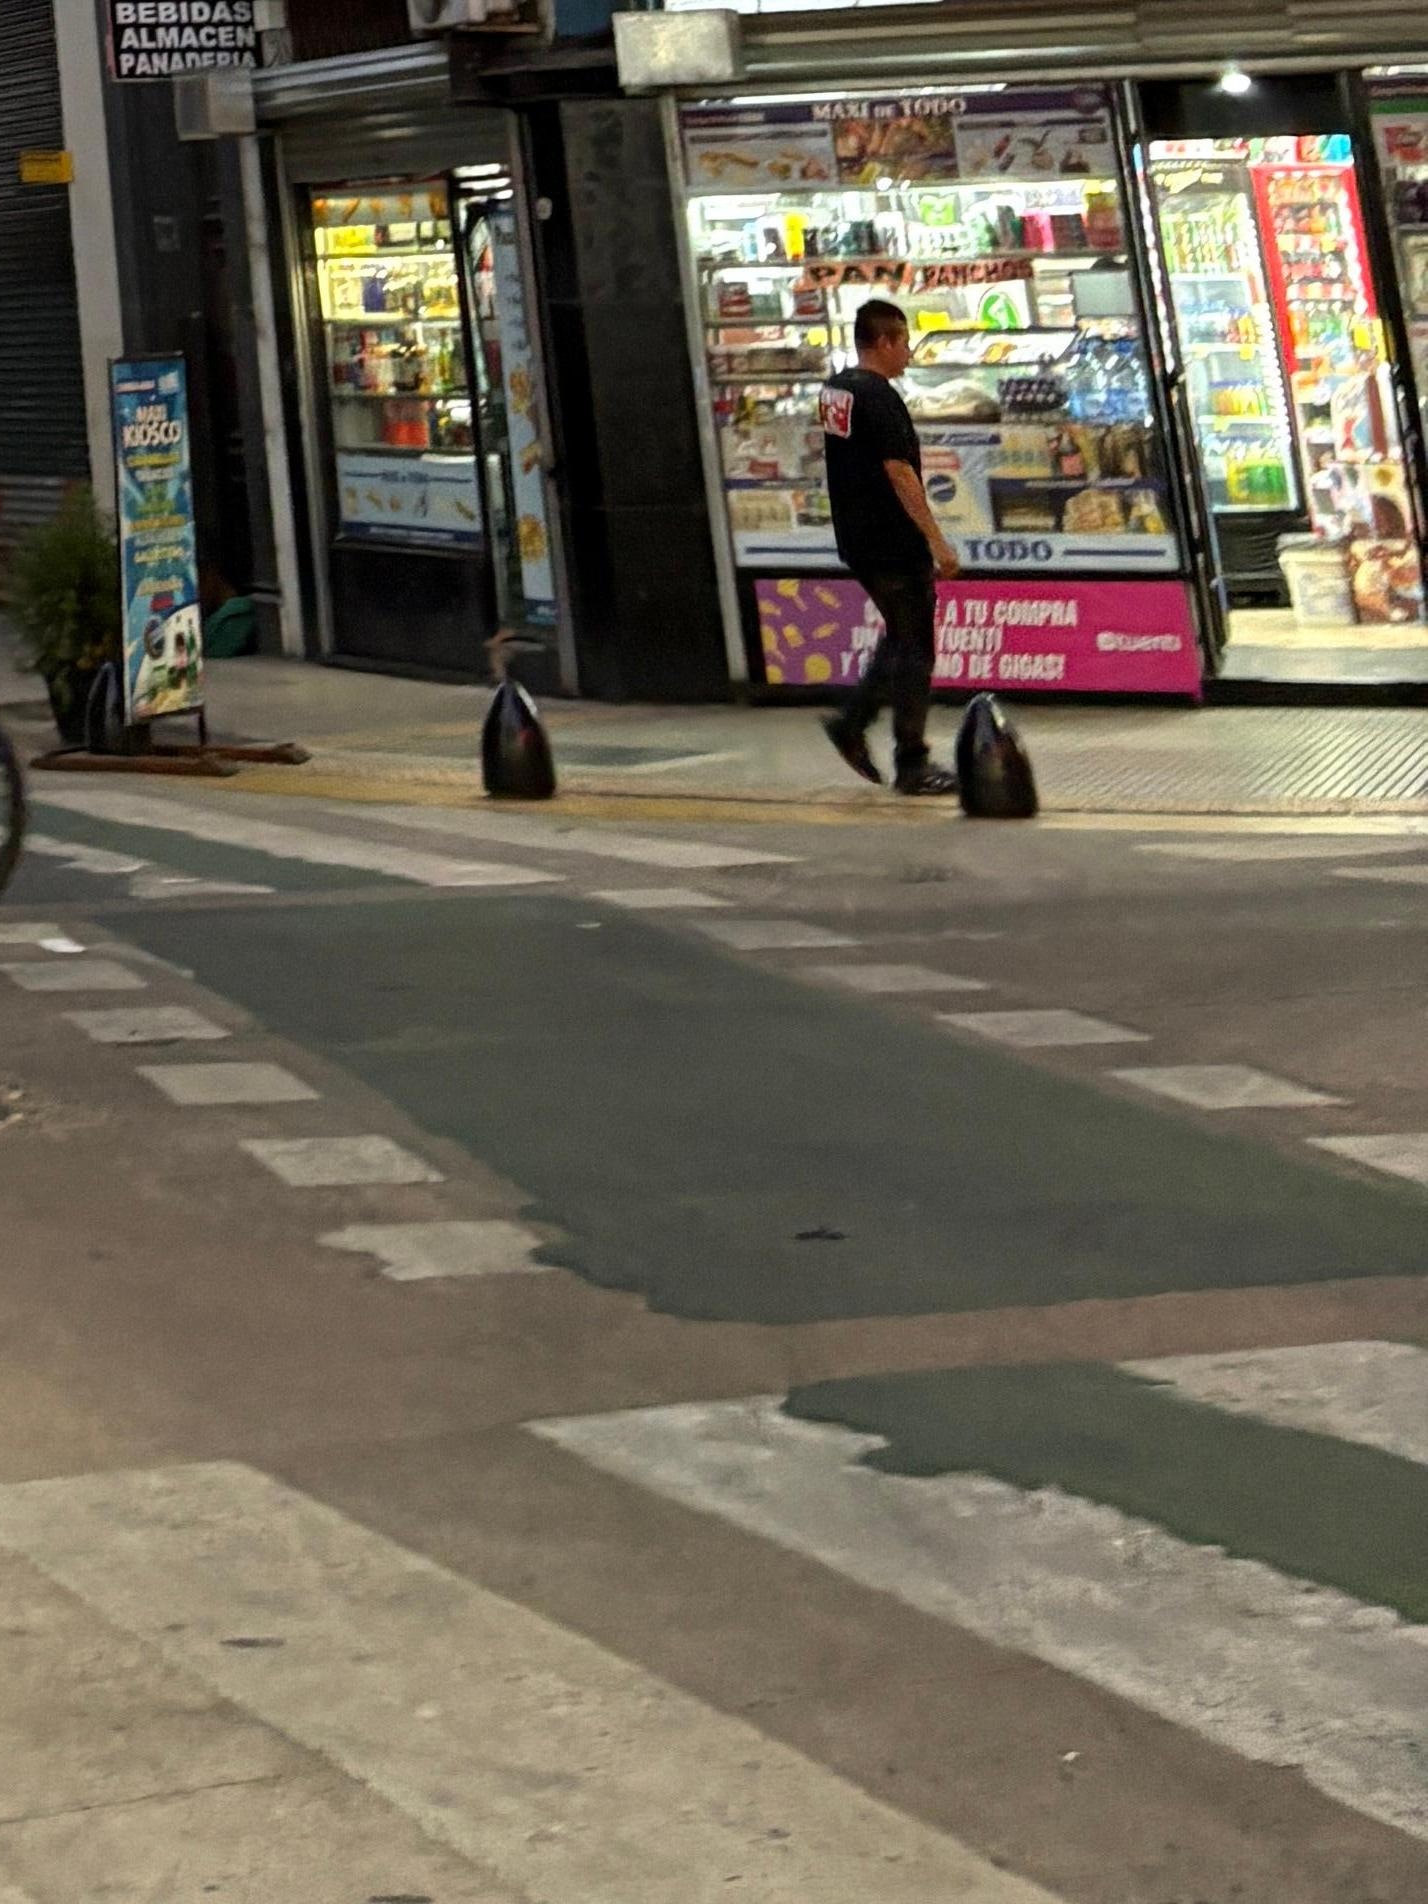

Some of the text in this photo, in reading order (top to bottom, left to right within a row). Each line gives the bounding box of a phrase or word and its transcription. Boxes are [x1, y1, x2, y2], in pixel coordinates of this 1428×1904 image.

[115, 0, 252, 24] BEBIDAS
[120, 25, 256, 49] ALMACEN
[123, 420, 182, 448] KIOSCO
[964, 540, 1053, 563] TODO
